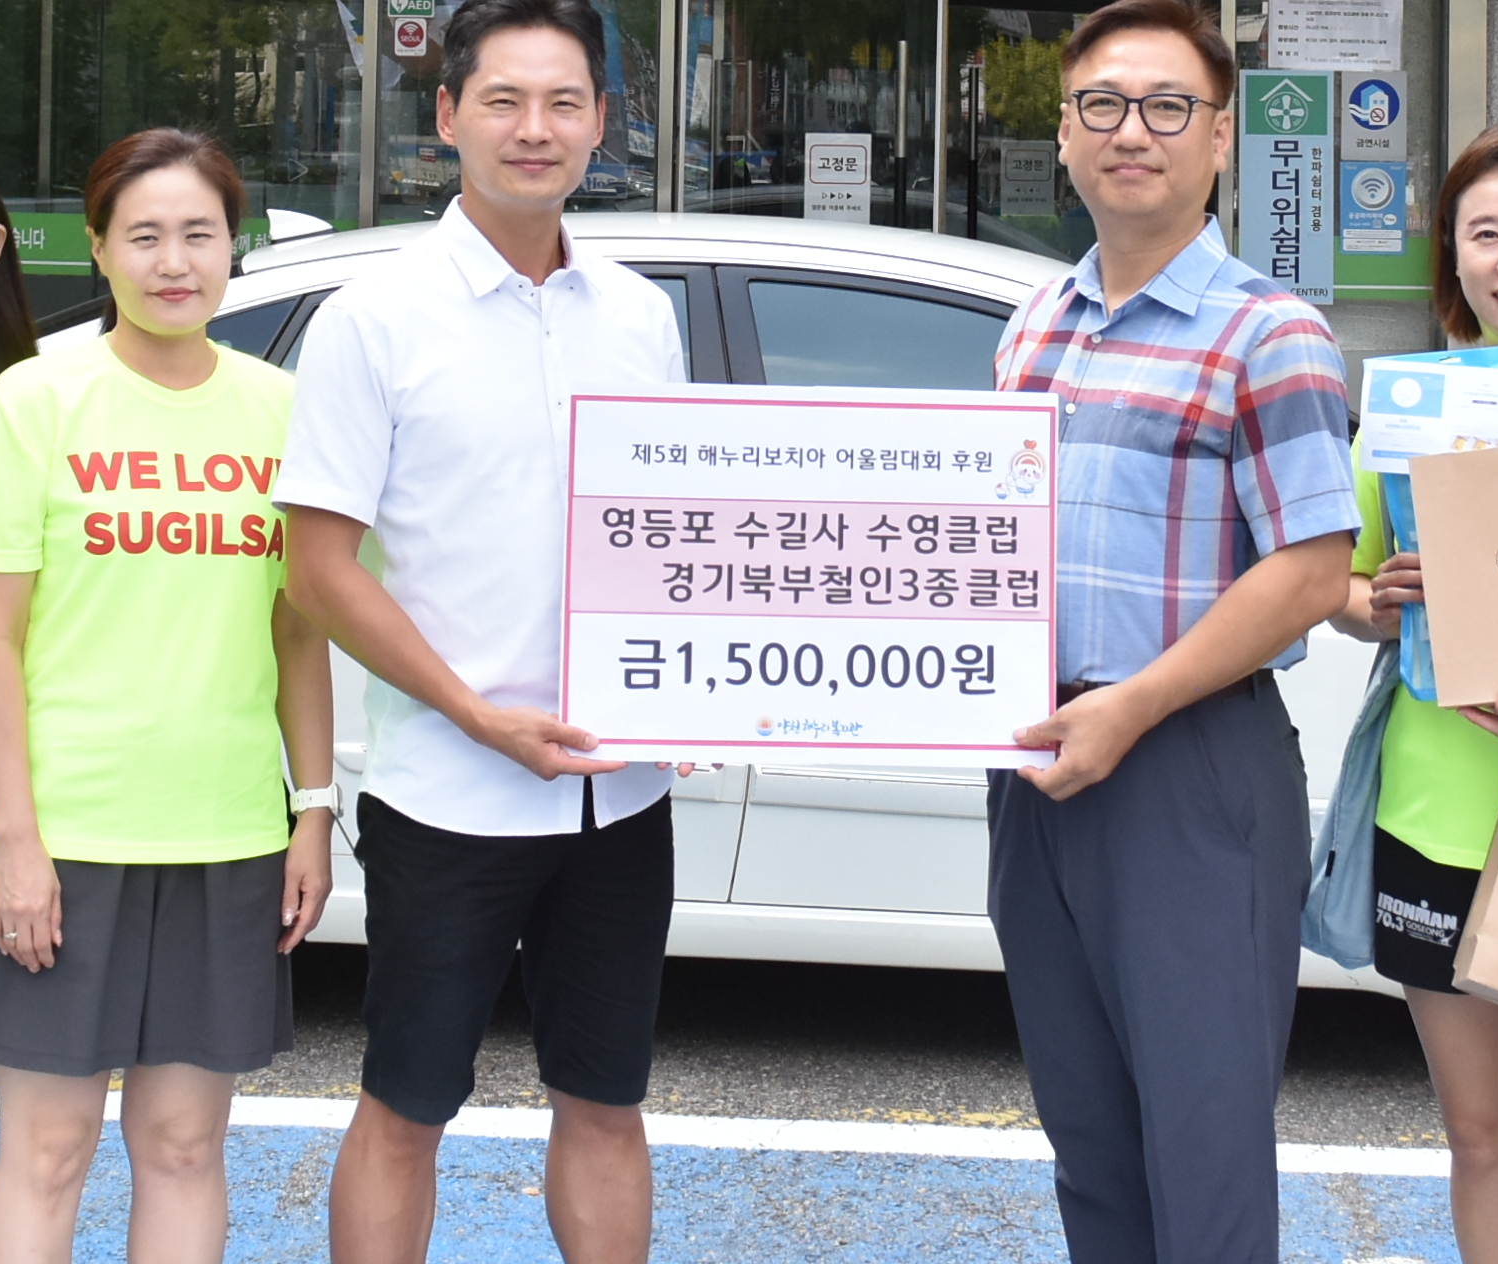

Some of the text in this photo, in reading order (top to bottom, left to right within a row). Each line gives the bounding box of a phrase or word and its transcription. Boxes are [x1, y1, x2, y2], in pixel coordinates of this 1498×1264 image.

[407, 0, 431, 11] AED
[400, 35, 422, 43] SEOUL
[1355, 138, 1390, 148] 금연시설
[817, 156, 859, 172] 고정문
[1011, 159, 1044, 172] 고정문
[1310, 147, 1323, 233] 한파쉼터 겸용
[1269, 139, 1303, 285] 무더위쉼터
[67, 451, 283, 495] WE LOV
[631, 442, 994, 474] 제5회 해누리보치아 어울림대회 후원
[84, 510, 284, 562] SUGILSA
[602, 506, 1019, 555] 영등포 수길사 수영클럽
[661, 562, 1041, 610] 경기북부철인3종클럽
[617, 637, 998, 697] 금1,500,000원
[1376, 908, 1405, 932] 70.3
[1405, 921, 1445, 938] GOSEONG
[1377, 891, 1458, 931] IRONMAN
